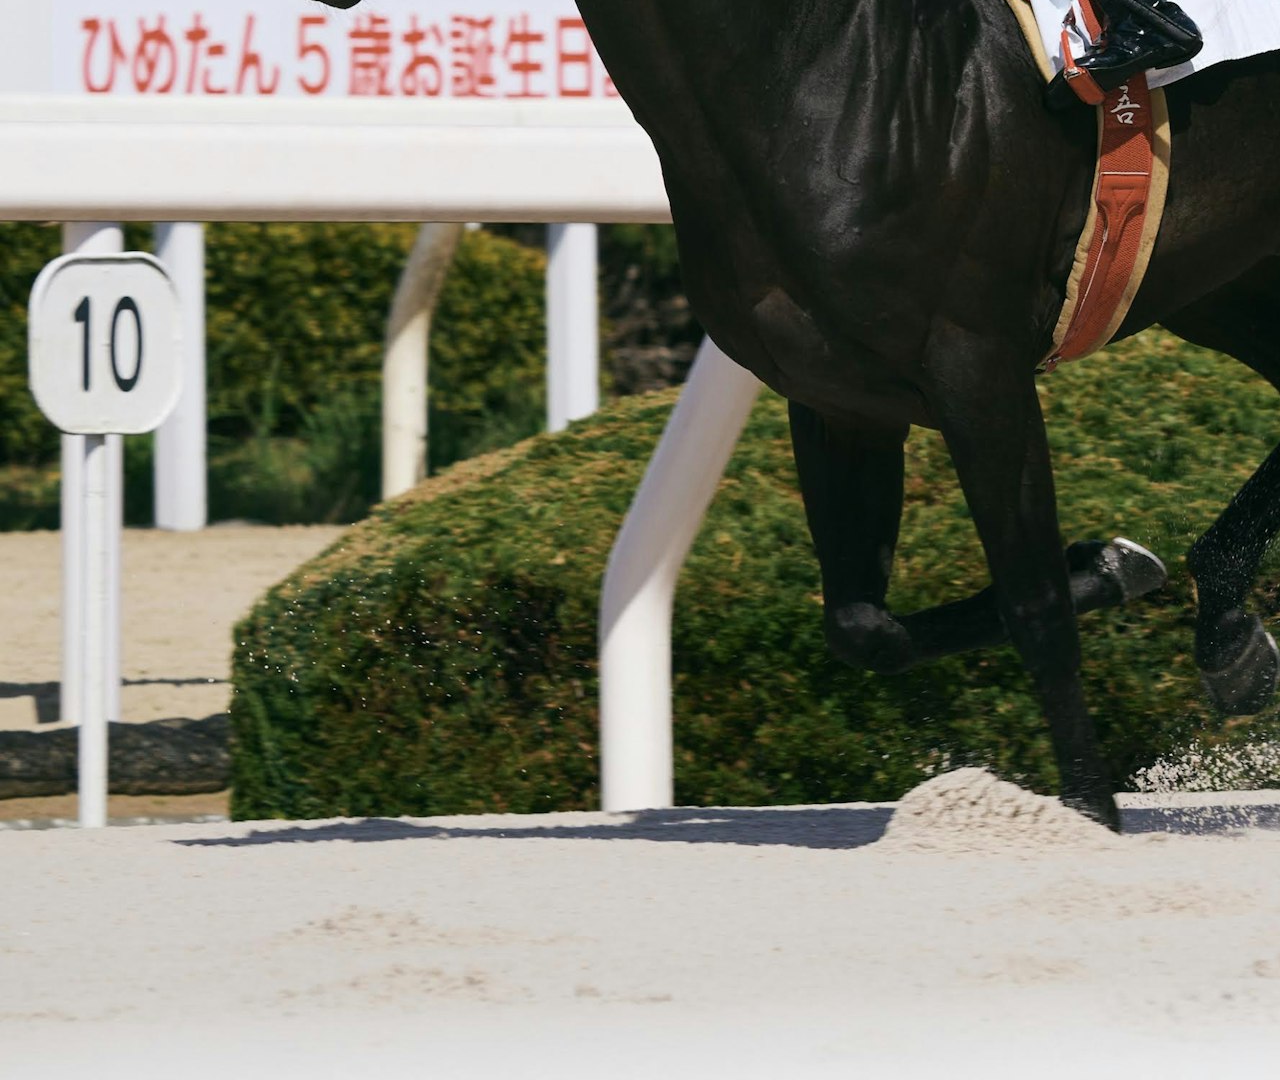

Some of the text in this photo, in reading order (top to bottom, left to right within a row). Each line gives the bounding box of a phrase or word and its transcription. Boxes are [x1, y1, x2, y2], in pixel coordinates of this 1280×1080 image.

[82, 12, 622, 98] ひめたん5歳お誕生日
[73, 295, 142, 392] 10
